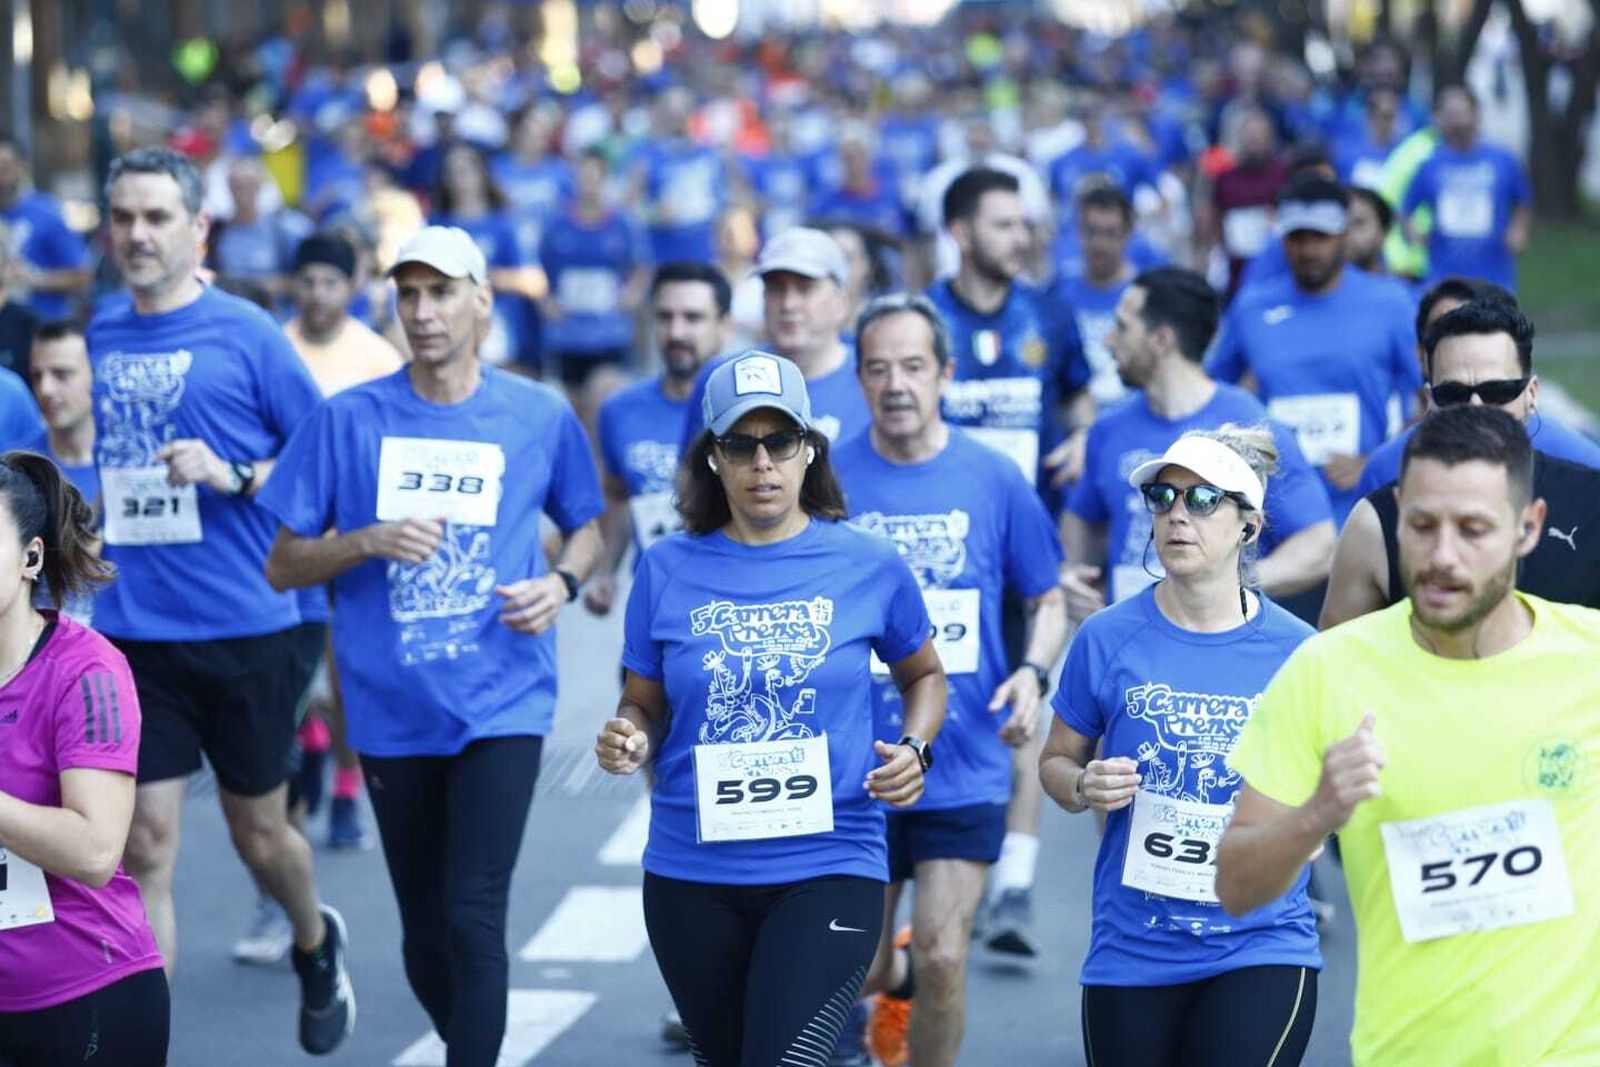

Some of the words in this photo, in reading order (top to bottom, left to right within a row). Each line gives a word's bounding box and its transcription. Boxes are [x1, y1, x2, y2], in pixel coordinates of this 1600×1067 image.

[398, 471, 484, 494] 338
[122, 498, 179, 518] 321
[711, 601, 812, 628] Carrera
[724, 621, 818, 643] Prensa
[1146, 688, 1250, 717] Carrera
[715, 774, 818, 804] 599
[1144, 832, 1217, 866] 63
[1420, 845, 1543, 894] 570
